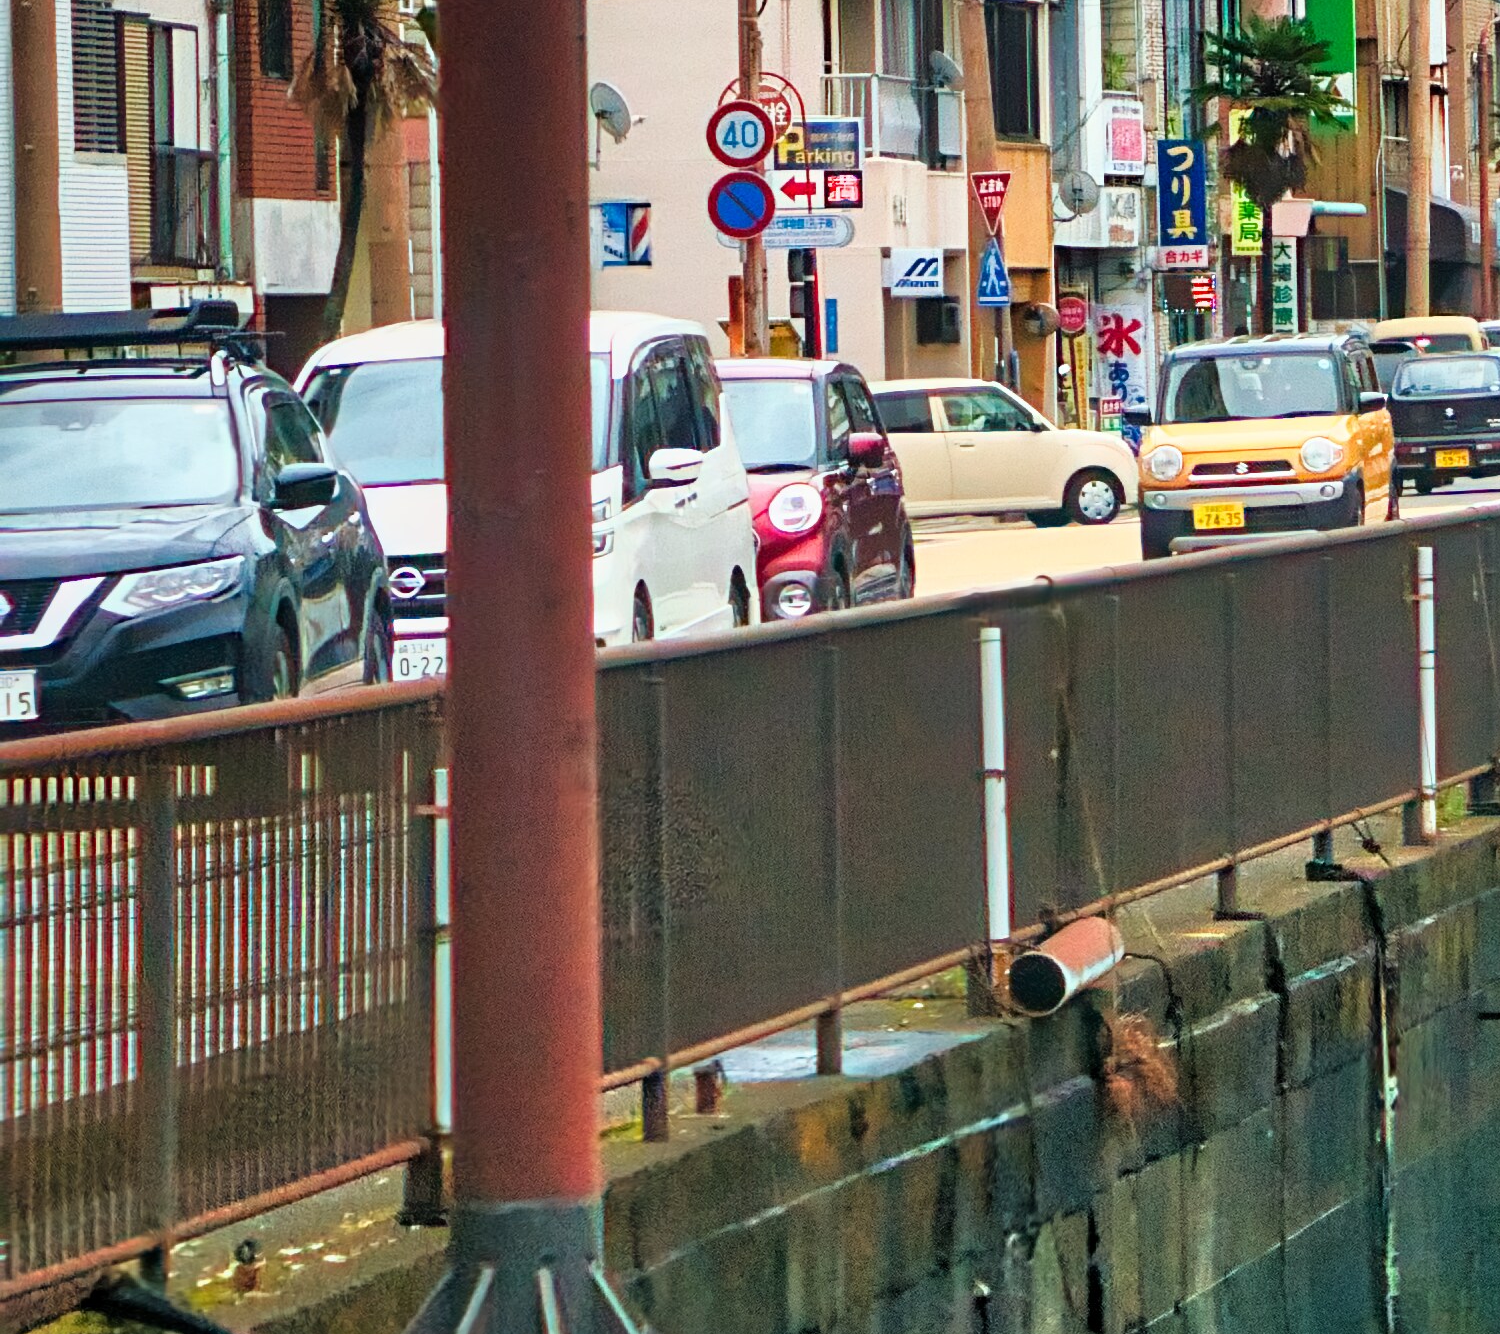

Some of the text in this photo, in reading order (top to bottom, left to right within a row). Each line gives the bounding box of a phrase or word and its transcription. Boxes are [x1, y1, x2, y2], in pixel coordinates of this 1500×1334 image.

[722, 120, 759, 149] 40
[777, 124, 856, 167] Parking
[980, 178, 1005, 193] 止まれ
[1166, 146, 1198, 240] つり具
[983, 196, 1001, 208] STOP
[1165, 249, 1203, 264] 合カギ
